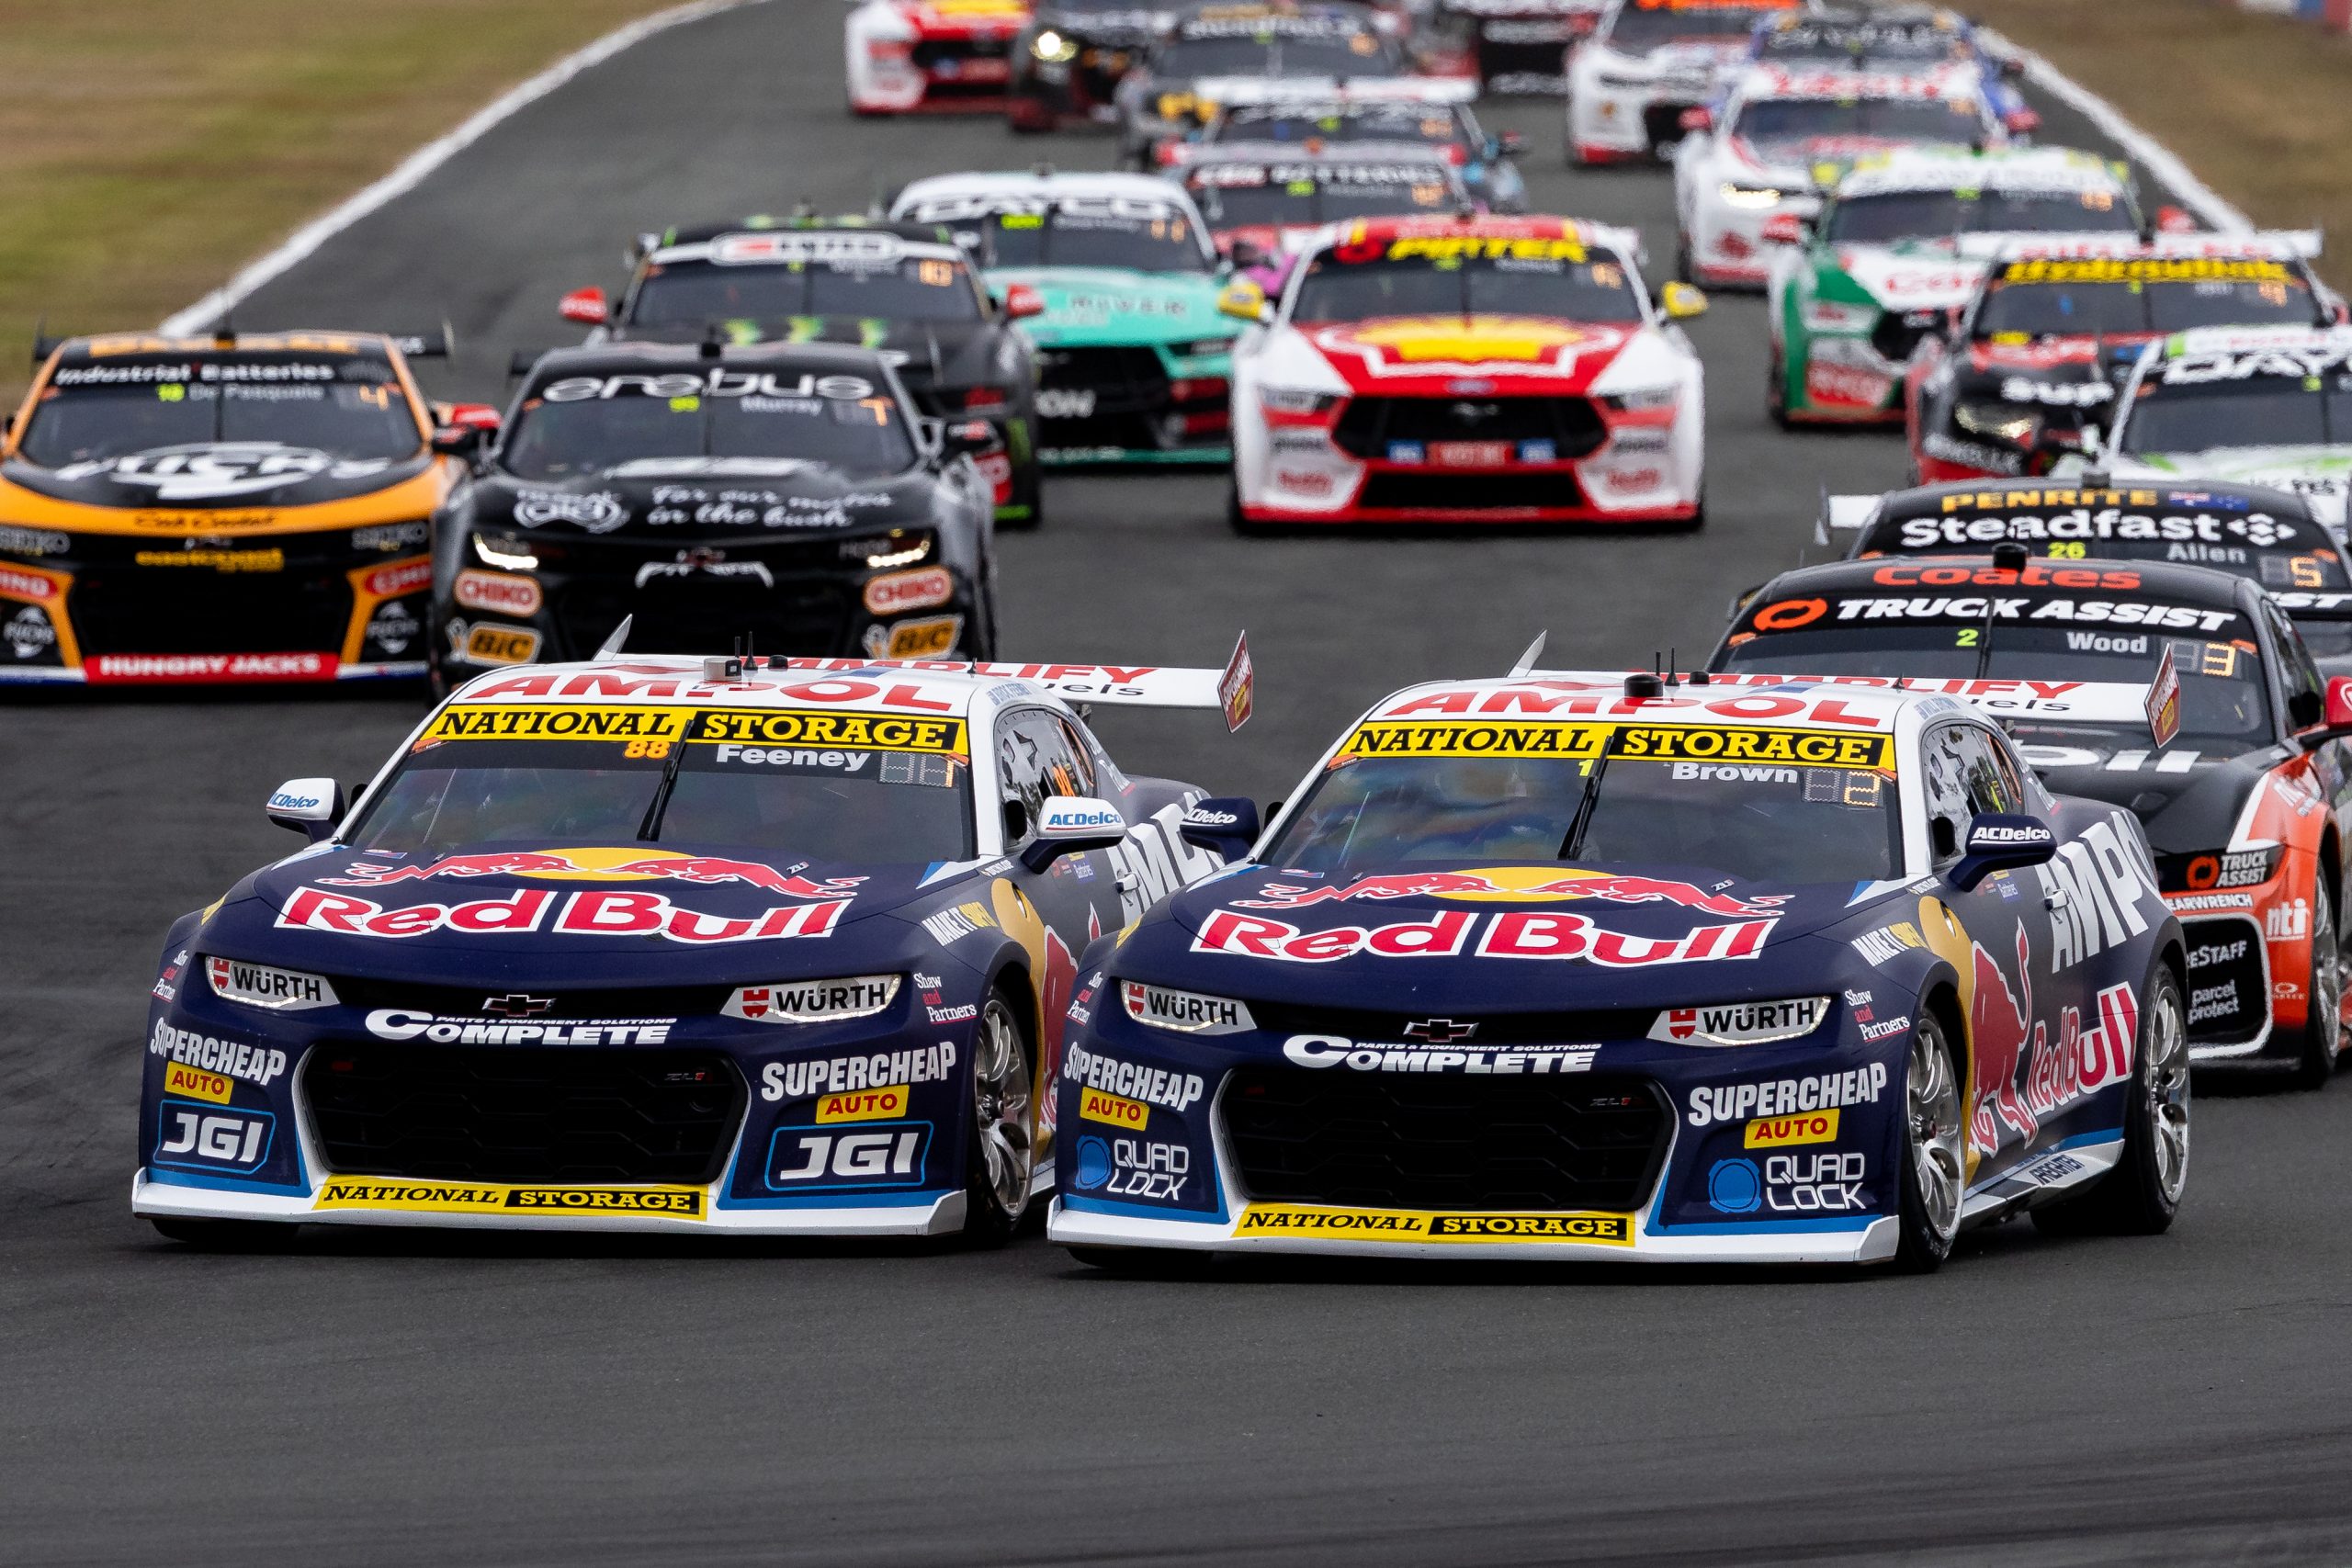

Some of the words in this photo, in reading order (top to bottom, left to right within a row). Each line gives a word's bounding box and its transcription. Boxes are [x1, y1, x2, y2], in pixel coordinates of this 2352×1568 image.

[55, 363, 191, 386] Industrial
[199, 362, 335, 382] Batteries
[2163, 346, 2352, 385] DAY
[741, 395, 825, 416] Murray
[695, 502, 759, 525] the
[1942, 489, 2158, 513] PENRITE
[1901, 510, 2222, 547] Steadfast
[2048, 542, 2086, 560] 26
[2167, 543, 2246, 563] Allen
[1873, 565, 2142, 591] Coates
[2290, 557, 2324, 589] 5
[1838, 597, 2030, 622] TRUCK
[2035, 600, 2237, 631] ASSIST
[1956, 629, 1978, 648] 2
[2067, 631, 2148, 655] Wood
[99, 657, 228, 676] HUNGRY
[229, 654, 321, 675] JACKS
[2201, 642, 2235, 677] 3
[1044, 683, 1145, 696] els
[1385, 691, 1881, 728] AMPOL
[1969, 695, 2071, 712] els
[435, 711, 677, 736] NATIONAL
[703, 713, 945, 749] STORAGE
[623, 740, 672, 760] 88
[1353, 727, 1594, 753] NATIONAL
[1623, 728, 1871, 763] STORAGE
[717, 745, 871, 772] Feeney
[1578, 759, 1595, 777] 1
[1672, 762, 1798, 783] Brown
[269, 793, 320, 808] CDelco
[1047, 811, 1122, 826] ACDelco
[1973, 826, 2051, 841] ACDelco
[2221, 851, 2268, 871] TRUCK
[2215, 867, 2267, 888] ASSIST
[275, 886, 556, 938] Red
[552, 891, 854, 944] Bull
[2166, 893, 2254, 912] EARWRENCH
[1192, 909, 1479, 963] Red
[1476, 912, 1780, 968] Bull
[233, 965, 322, 1003] WÜRTH
[913, 973, 943, 989] Shaw
[2191, 979, 2237, 1008] parcel
[776, 982, 887, 1013] WÜRTH
[922, 988, 943, 1006] and
[1148, 990, 1239, 1027] WÜRTH
[1845, 988, 1873, 1007] Shaw
[926, 1004, 978, 1022] Partners
[1703, 1000, 1815, 1034] WÜRTH
[1854, 1005, 1875, 1024] and
[2188, 997, 2240, 1025] protect
[366, 1009, 671, 1045] COMPLETE
[1859, 1016, 1910, 1040] Partners
[150, 1017, 287, 1086] SUPERCHEAP
[1283, 1034, 1597, 1074] COMPLETE
[172, 1070, 227, 1096] AUTO
[762, 1041, 956, 1102] SUPERCHEAP
[1063, 1042, 1204, 1112] SUPERCHEAP
[824, 1092, 899, 1116] AUTO
[1689, 1063, 1888, 1127] SUPERCHEAP
[1087, 1097, 1142, 1123] AUTO
[162, 1112, 264, 1163] JGI
[1754, 1117, 1829, 1141] AUTO
[781, 1133, 919, 1181] JGI
[1114, 1139, 1190, 1176] QUAD
[1766, 1153, 1866, 1182] QUAD
[322, 1185, 502, 1205] NATIONAL
[519, 1190, 692, 1211] STORAGE
[1106, 1170, 1188, 1201] LOCK
[1766, 1182, 1867, 1211] LOCK
[1243, 1213, 1424, 1233] NATIONAL
[1442, 1217, 1621, 1237] STORAGE
